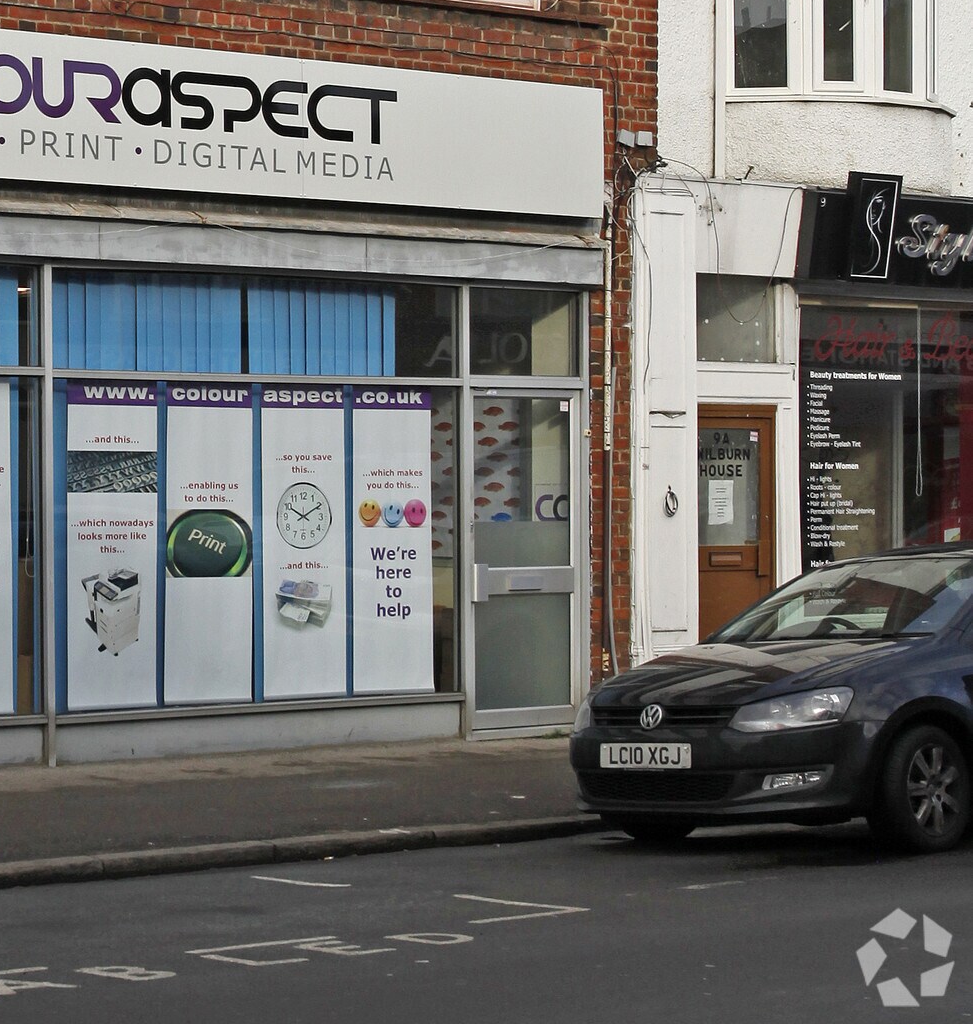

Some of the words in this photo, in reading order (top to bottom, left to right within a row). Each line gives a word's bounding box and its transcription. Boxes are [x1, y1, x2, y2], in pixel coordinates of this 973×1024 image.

[19, 130, 123, 162] PRINT
[154, 139, 286, 174] DIGITAL
[297, 150, 394, 181] MEDIA
[810, 371, 832, 380] Beauty
[83, 386, 155, 400] www.
[172, 386, 248, 402] colour
[263, 388, 343, 406] aspect
[356, 390, 423, 404] .co.uk
[85, 435, 111, 443] ...and
[113, 435, 139, 444] this...
[295, 454, 310, 462] you
[291, 465, 315, 474] this...
[363, 468, 395, 477] ...which
[397, 469, 423, 477] makes
[699, 465, 742, 477] HOUSE
[180, 481, 226, 491] ...enabling
[367, 482, 382, 491] you
[384, 481, 394, 489] do
[396, 481, 419, 489] this...
[184, 494, 194, 502] to
[196, 494, 207, 502] do
[209, 494, 234, 502] this...
[299, 492, 308, 500] 12
[71, 519, 106, 527] ...which
[109, 519, 154, 528] nowadays
[77, 532, 102, 540] looks
[130, 532, 147, 540] like
[188, 528, 227, 555] Print
[100, 545, 125, 553] this...
[371, 546, 417, 561] We're
[280, 562, 303, 570] ...and
[305, 561, 329, 570] this...
[376, 565, 412, 579] here
[386, 585, 402, 598] to
[377, 603, 411, 619] help
[609, 746, 642, 764] LC10
[648, 747, 681, 765] XGJ
